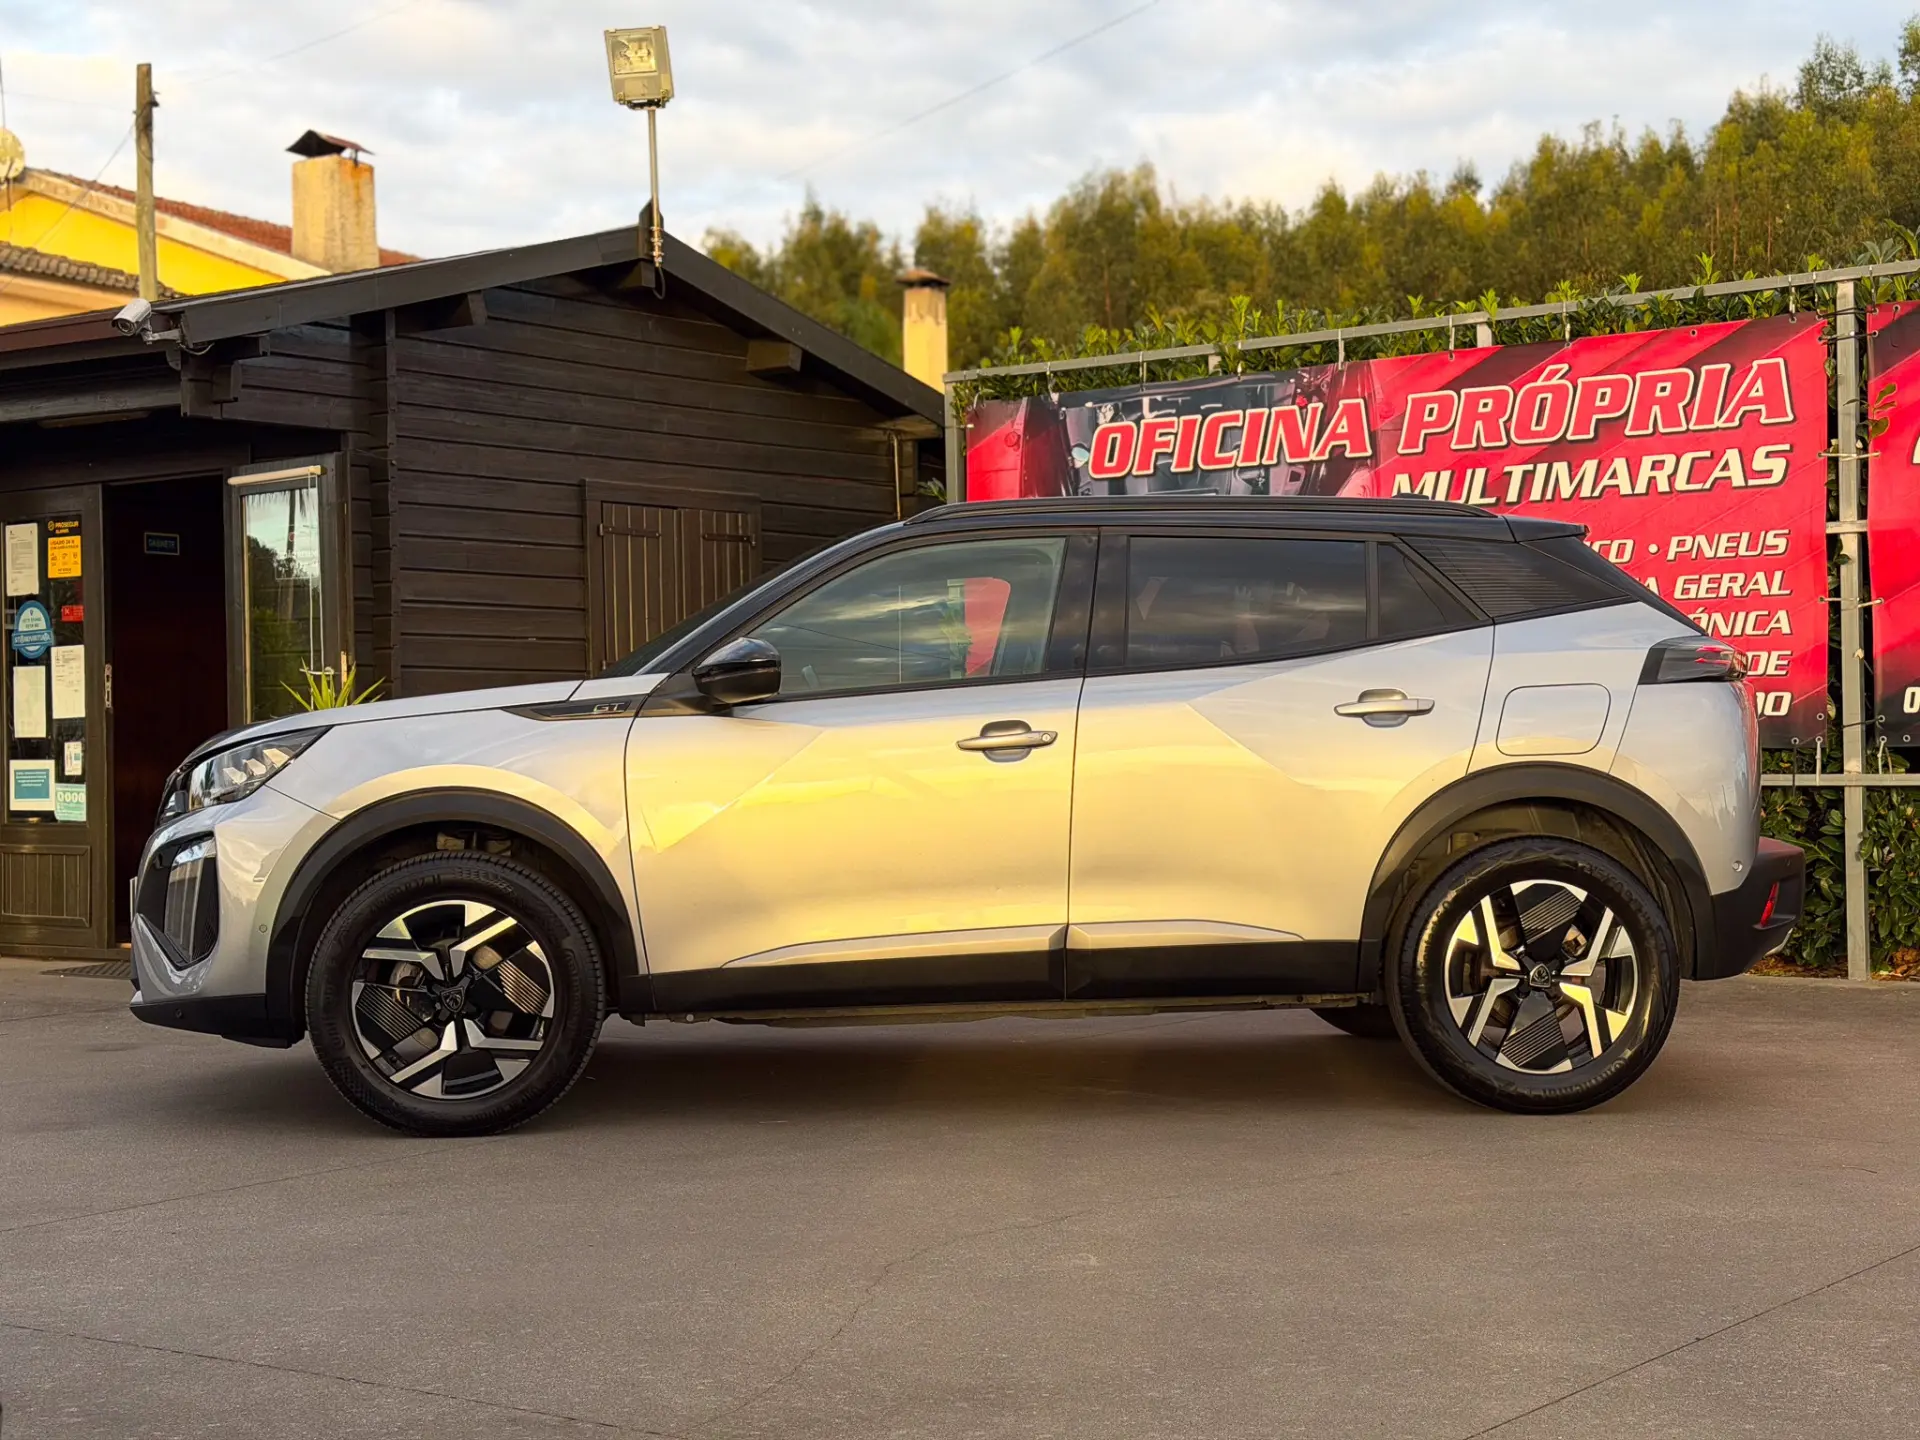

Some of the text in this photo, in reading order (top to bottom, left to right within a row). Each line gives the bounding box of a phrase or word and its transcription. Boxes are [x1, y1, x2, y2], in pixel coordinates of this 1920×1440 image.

[1088, 357, 1795, 479] OFICINA PRÓPRIA
[1391, 443, 1791, 505] MULTIMARCAS
[1583, 529, 1791, 565] CO PNEUS
[1673, 570, 1792, 600] GERAL
[593, 702, 625, 713] GT
